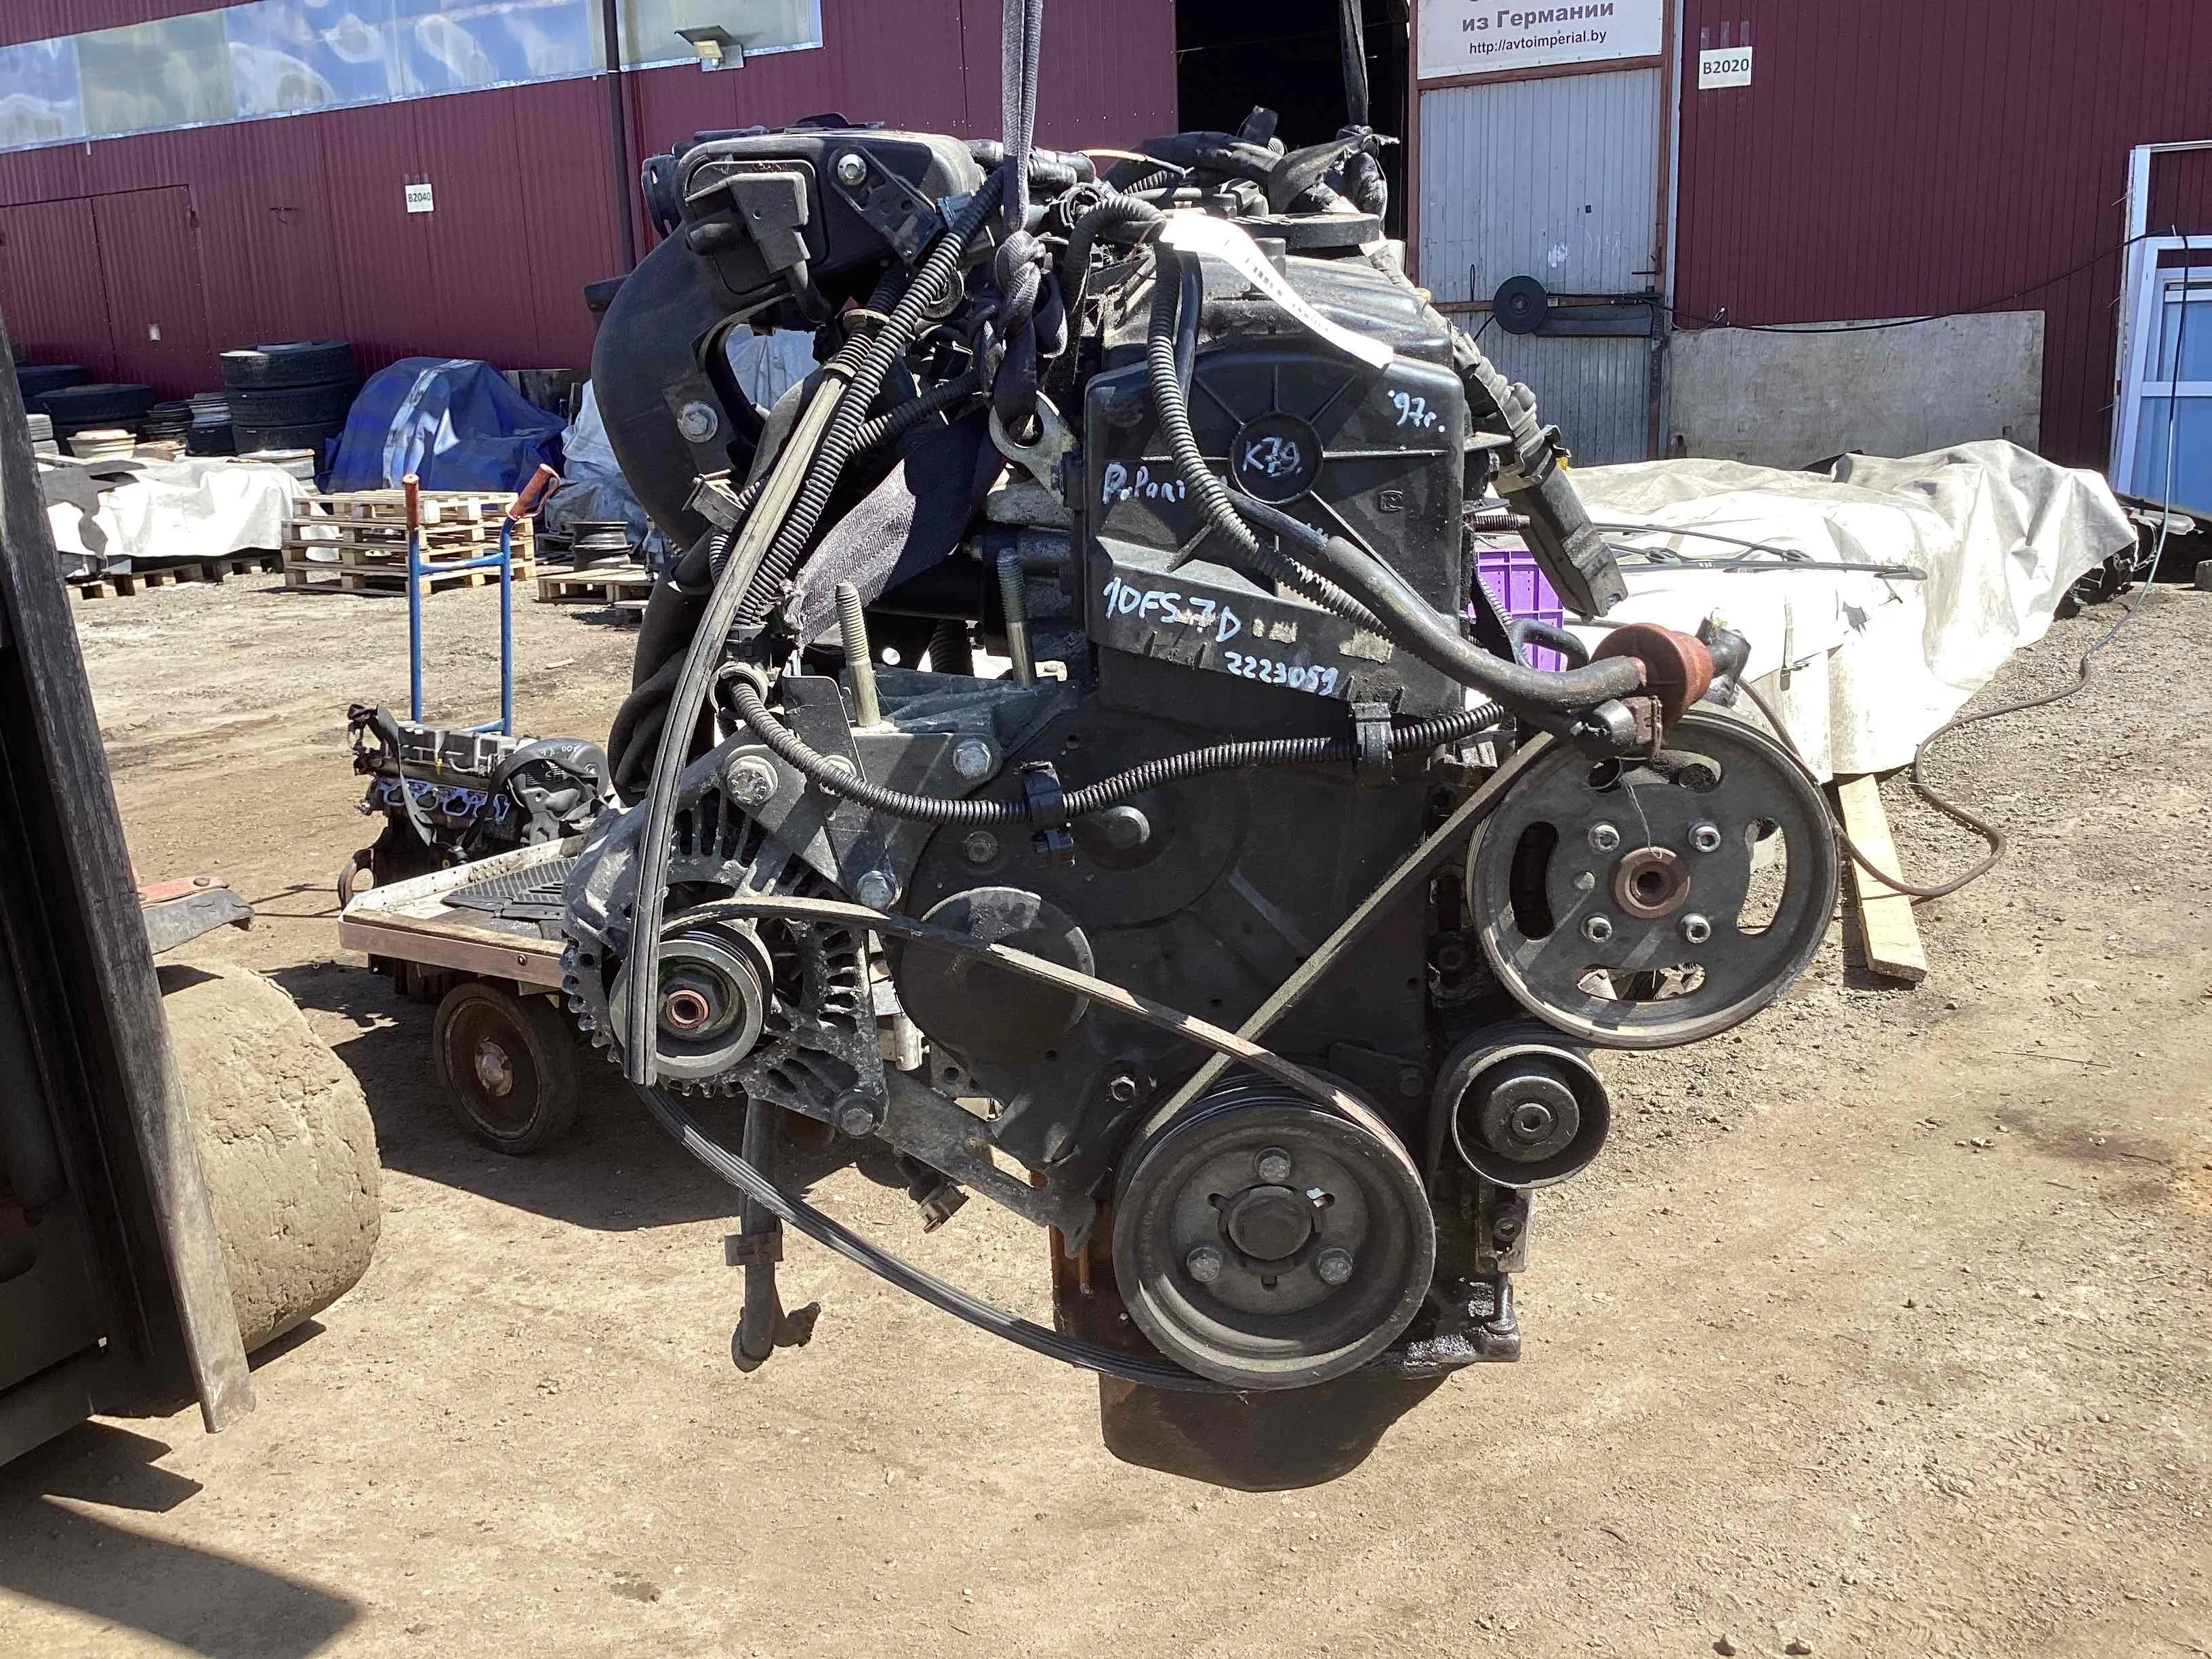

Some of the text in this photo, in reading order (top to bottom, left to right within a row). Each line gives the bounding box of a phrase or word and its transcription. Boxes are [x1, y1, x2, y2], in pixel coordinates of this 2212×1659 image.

[1462, 1, 1614, 32] из Германии
[1469, 30, 1607, 54] http://avtoimperial.by
[1703, 58, 1750, 75] B2020
[1224, 651, 1339, 696] 2223059
